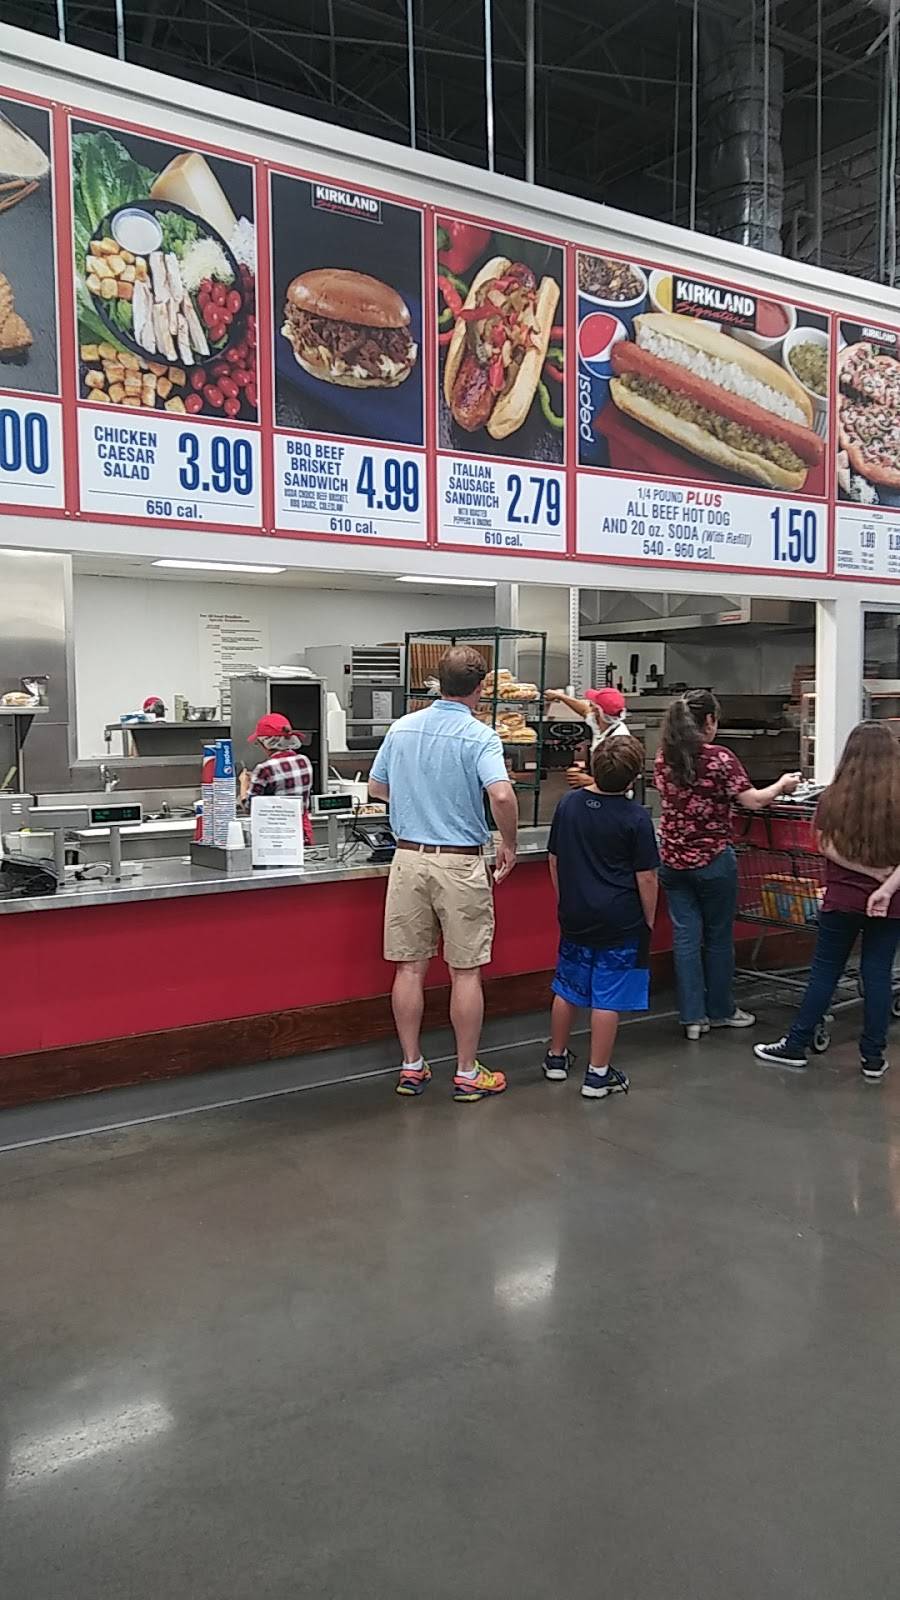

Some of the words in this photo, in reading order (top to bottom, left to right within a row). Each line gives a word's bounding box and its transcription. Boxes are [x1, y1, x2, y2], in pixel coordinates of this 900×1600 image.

[316, 186, 378, 213] KIRKLAND
[677, 280, 755, 316] KIRKLAND
[579, 372, 595, 442] pepsi
[94, 425, 157, 448] CHICKEN
[98, 443, 155, 464] CAESAR
[287, 440, 311, 457] BBQ
[316, 444, 345, 460] BEEF
[103, 462, 150, 481] SALAD
[179, 432, 253, 495] 3.99
[291, 457, 341, 475] BRISKET
[453, 462, 491, 479] ITALIAN
[284, 472, 348, 492] SANDWICH
[356, 456, 419, 512] 4.99
[449, 477, 495, 493] SAUSAGE
[445, 491, 499, 508] SANDWICH
[507, 474, 560, 526] 2.79
[637, 487, 651, 499] 1/4
[653, 489, 684, 503] POUND
[686, 490, 722, 508] PLUS
[146, 500, 171, 516] 650
[177, 503, 202, 519] cal.
[627, 501, 648, 518] ALL
[652, 504, 679, 521] BEEF
[683, 507, 704, 523] HOT
[707, 510, 730, 526] DOG
[330, 517, 351, 532] 610
[355, 521, 377, 534] cal.
[602, 517, 628, 535] AND
[631, 520, 645, 536] 20
[649, 525, 664, 538] oz.
[668, 524, 699, 541] SODA
[770, 506, 817, 564] 1.50
[484, 532, 502, 545] 610
[505, 534, 523, 547] cal.
[643, 540, 664, 556] 540
[675, 542, 694, 559] 960
[697, 545, 715, 560] cal.
